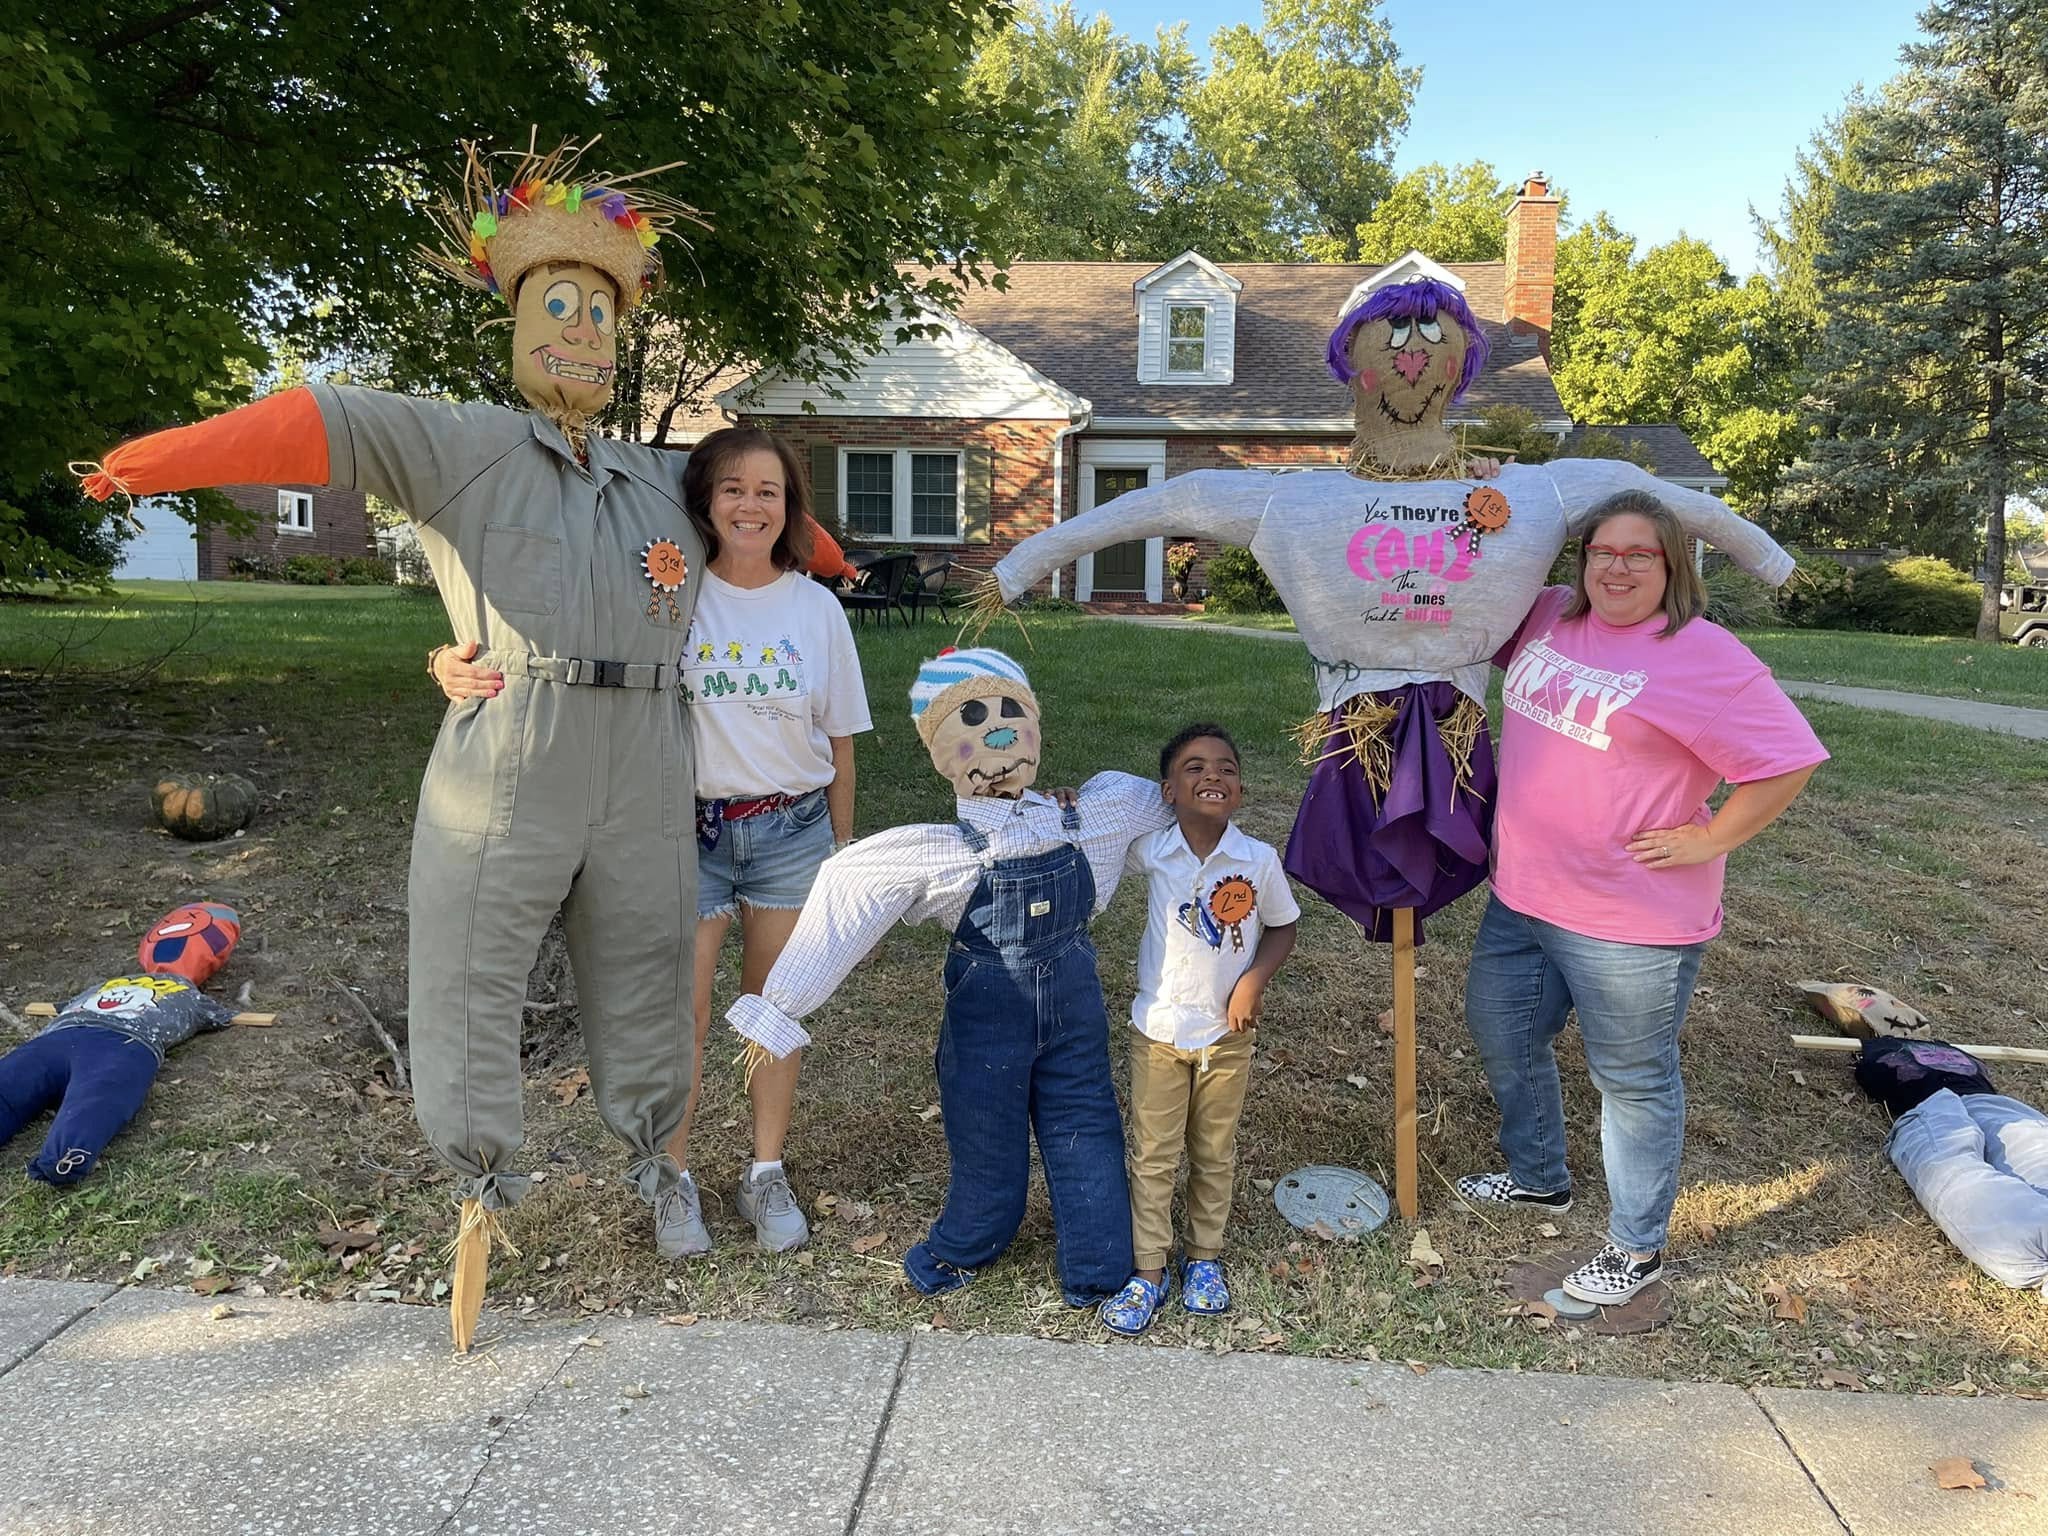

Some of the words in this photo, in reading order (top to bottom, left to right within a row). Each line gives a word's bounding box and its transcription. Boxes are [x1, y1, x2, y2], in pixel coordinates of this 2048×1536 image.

[1364, 497, 1390, 523] Yes
[1390, 505, 1460, 522] They're
[1474, 494, 1503, 518] 1st
[656, 549, 681, 573] 3rd
[1391, 569, 1420, 593] The
[1414, 594, 1446, 606] ones
[1360, 606, 1389, 624] Tried
[1387, 607, 1403, 621] to
[1539, 648, 1569, 667] FIGHT
[1566, 663, 1587, 675] FOR
[1593, 671, 1620, 684] CURE
[1504, 692, 1550, 725] SEPTEMBER
[1568, 724, 1593, 743] 2024
[1220, 888, 1248, 914] 2nd
